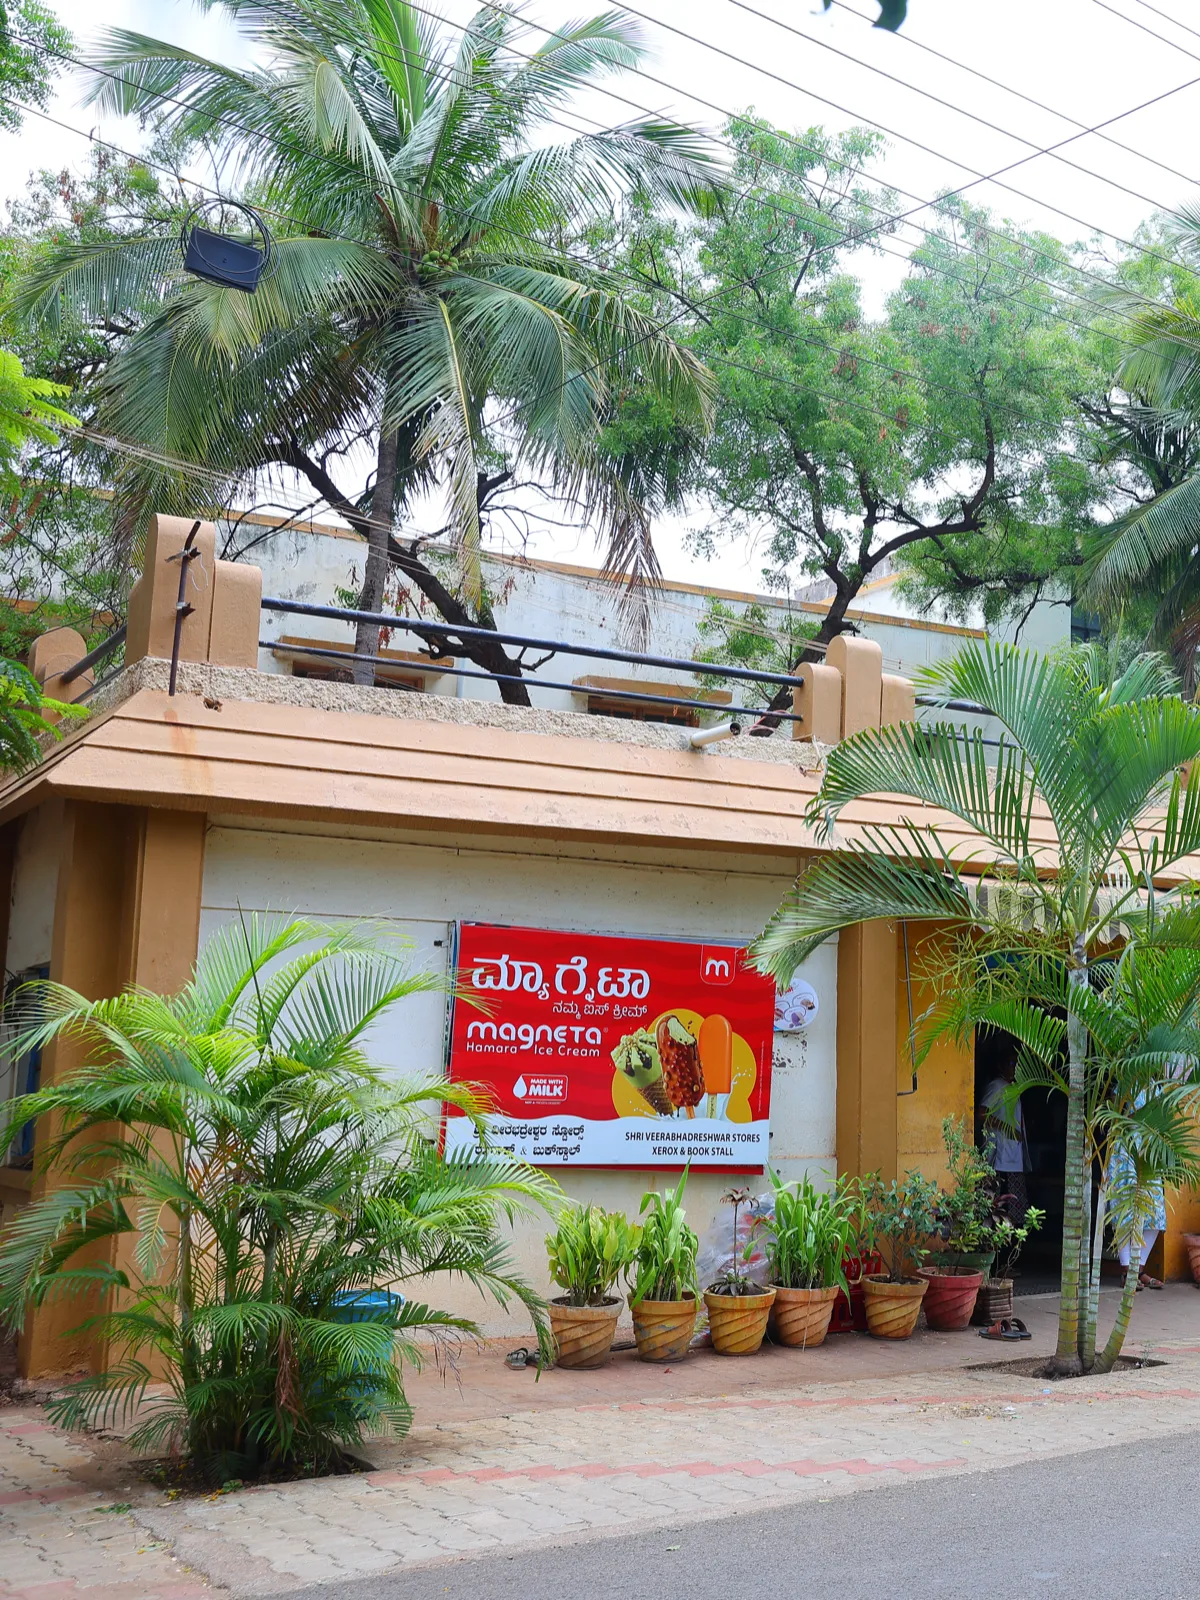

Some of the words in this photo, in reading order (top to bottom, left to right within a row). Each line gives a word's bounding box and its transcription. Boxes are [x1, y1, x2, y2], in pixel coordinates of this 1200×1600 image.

[552, 1000, 582, 1019] ನಮ್ಮ
[584, 1002, 609, 1017] ಐಸ್
[613, 1004, 647, 1020] ಕ್ರೀಮ್
[466, 1041, 517, 1054] Hamara
[534, 1044, 553, 1056] Ice
[558, 1045, 600, 1057] Cream
[529, 1084, 563, 1097] MILK
[625, 1131, 644, 1141] SHRI
[645, 1132, 730, 1142] VEERABHADRESHWAR
[732, 1133, 761, 1143] STORES
[520, 1147, 527, 1155] &
[652, 1146, 678, 1156] XEROX
[680, 1147, 686, 1156] &
[687, 1146, 710, 1156] BOOK
[711, 1147, 734, 1156] STALL
